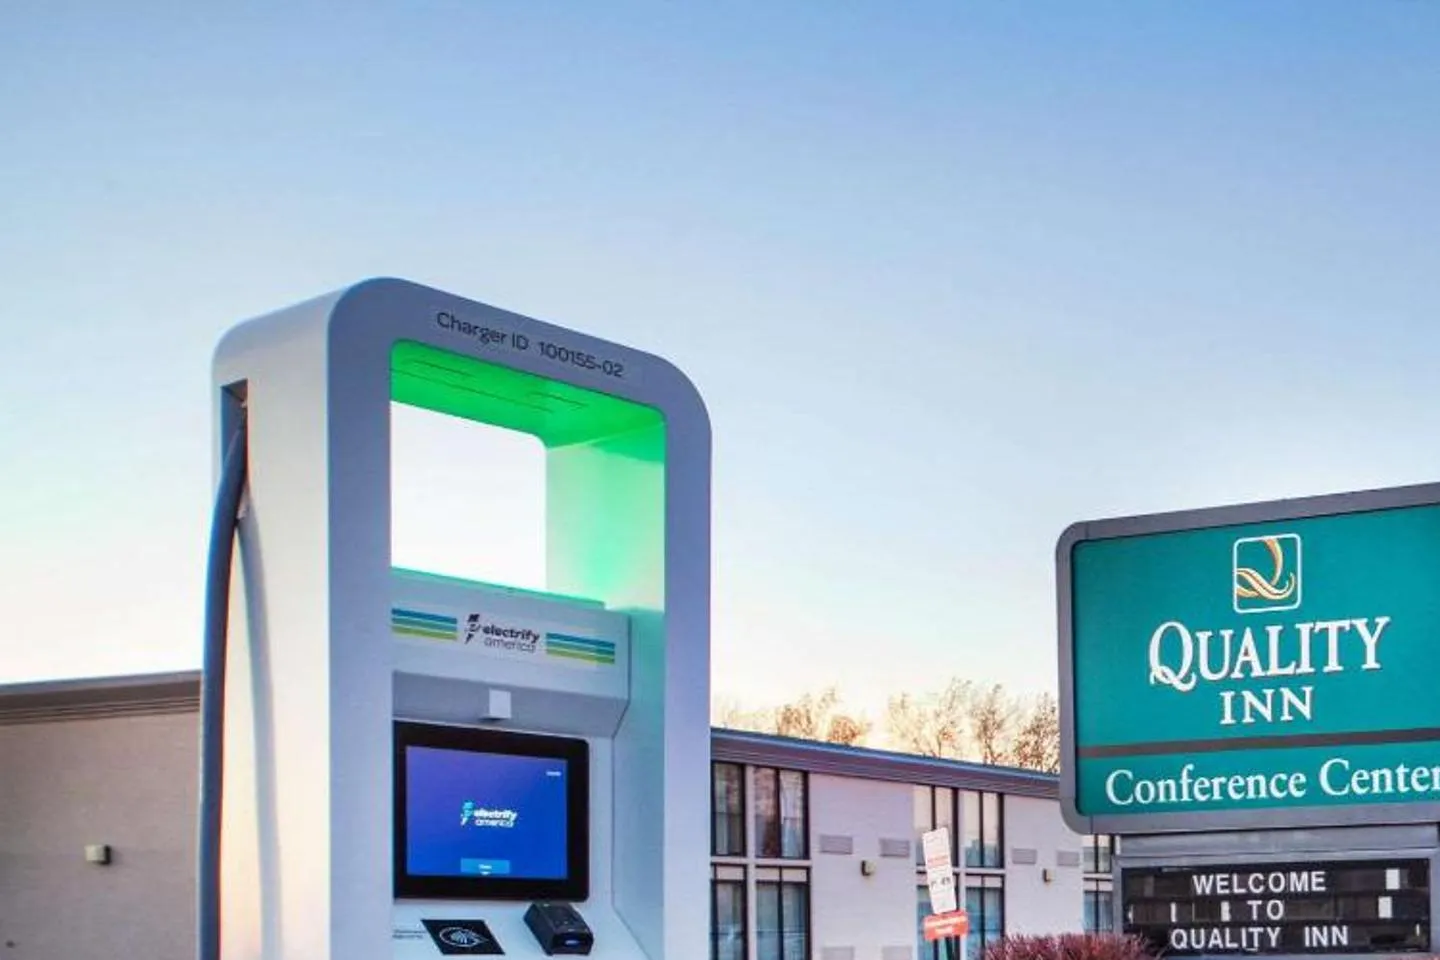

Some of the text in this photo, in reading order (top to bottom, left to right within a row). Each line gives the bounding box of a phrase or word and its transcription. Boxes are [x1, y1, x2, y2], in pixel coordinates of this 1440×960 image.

[436, 311, 624, 377] Charger ID 100155-02
[482, 624, 540, 644] electrify
[484, 637, 536, 653] america
[1149, 616, 1391, 692] QUALITY
[1219, 685, 1314, 725] INN
[1106, 763, 1307, 806] Conference
[1192, 871, 1327, 895] WELCOME
[1247, 900, 1285, 921] TO
[1170, 925, 1349, 950] QUALITY INN
